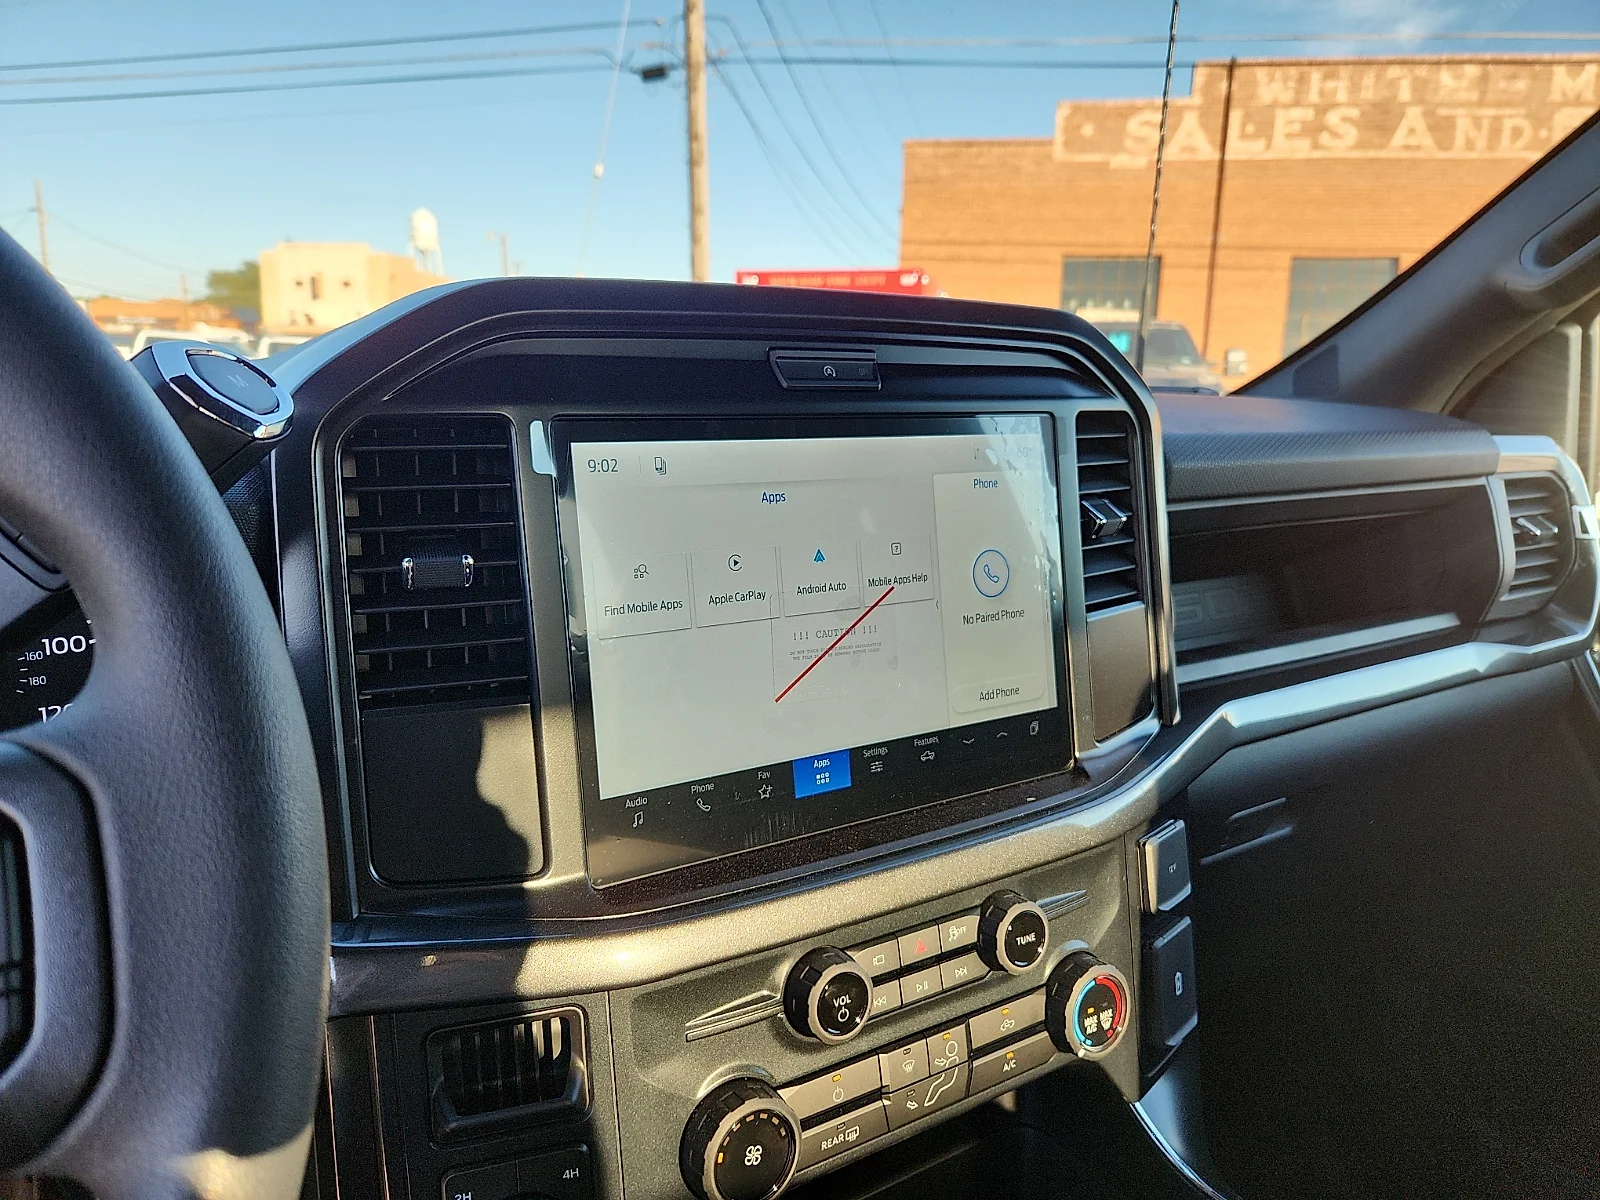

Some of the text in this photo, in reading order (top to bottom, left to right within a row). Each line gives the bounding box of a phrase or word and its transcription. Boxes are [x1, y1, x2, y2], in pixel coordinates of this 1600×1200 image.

[1122, 104, 1361, 151] SALES
[587, 458, 619, 473] 9:02
[973, 478, 998, 489] Phone
[761, 491, 786, 504] Apps
[867, 573, 928, 588] Mobile Apps Help
[796, 582, 847, 596] Android Auto
[708, 590, 766, 606] Apple CarPlay
[604, 600, 683, 617] Find Mobile Apps
[962, 608, 1025, 625] No Paired Phone
[41, 635, 87, 656] 100
[25, 650, 44, 661] 160
[28, 675, 47, 686] 180
[979, 686, 1020, 702] Add Phone
[914, 736, 939, 747] Features
[863, 746, 888, 758] Settings
[813, 757, 831, 769] Apps
[757, 770, 771, 780] Fav
[691, 782, 715, 795] Phone
[625, 796, 648, 809] Audio
[955, 924, 968, 935] OFF
[1016, 932, 1036, 945] TUNE
[833, 995, 852, 1007] VOL
[1083, 1014, 1098, 1027] MAX
[1086, 1023, 1098, 1035] A/C
[1002, 1060, 1017, 1073] A/C
[820, 1133, 845, 1150] REAR
[562, 1167, 580, 1180] 4H
